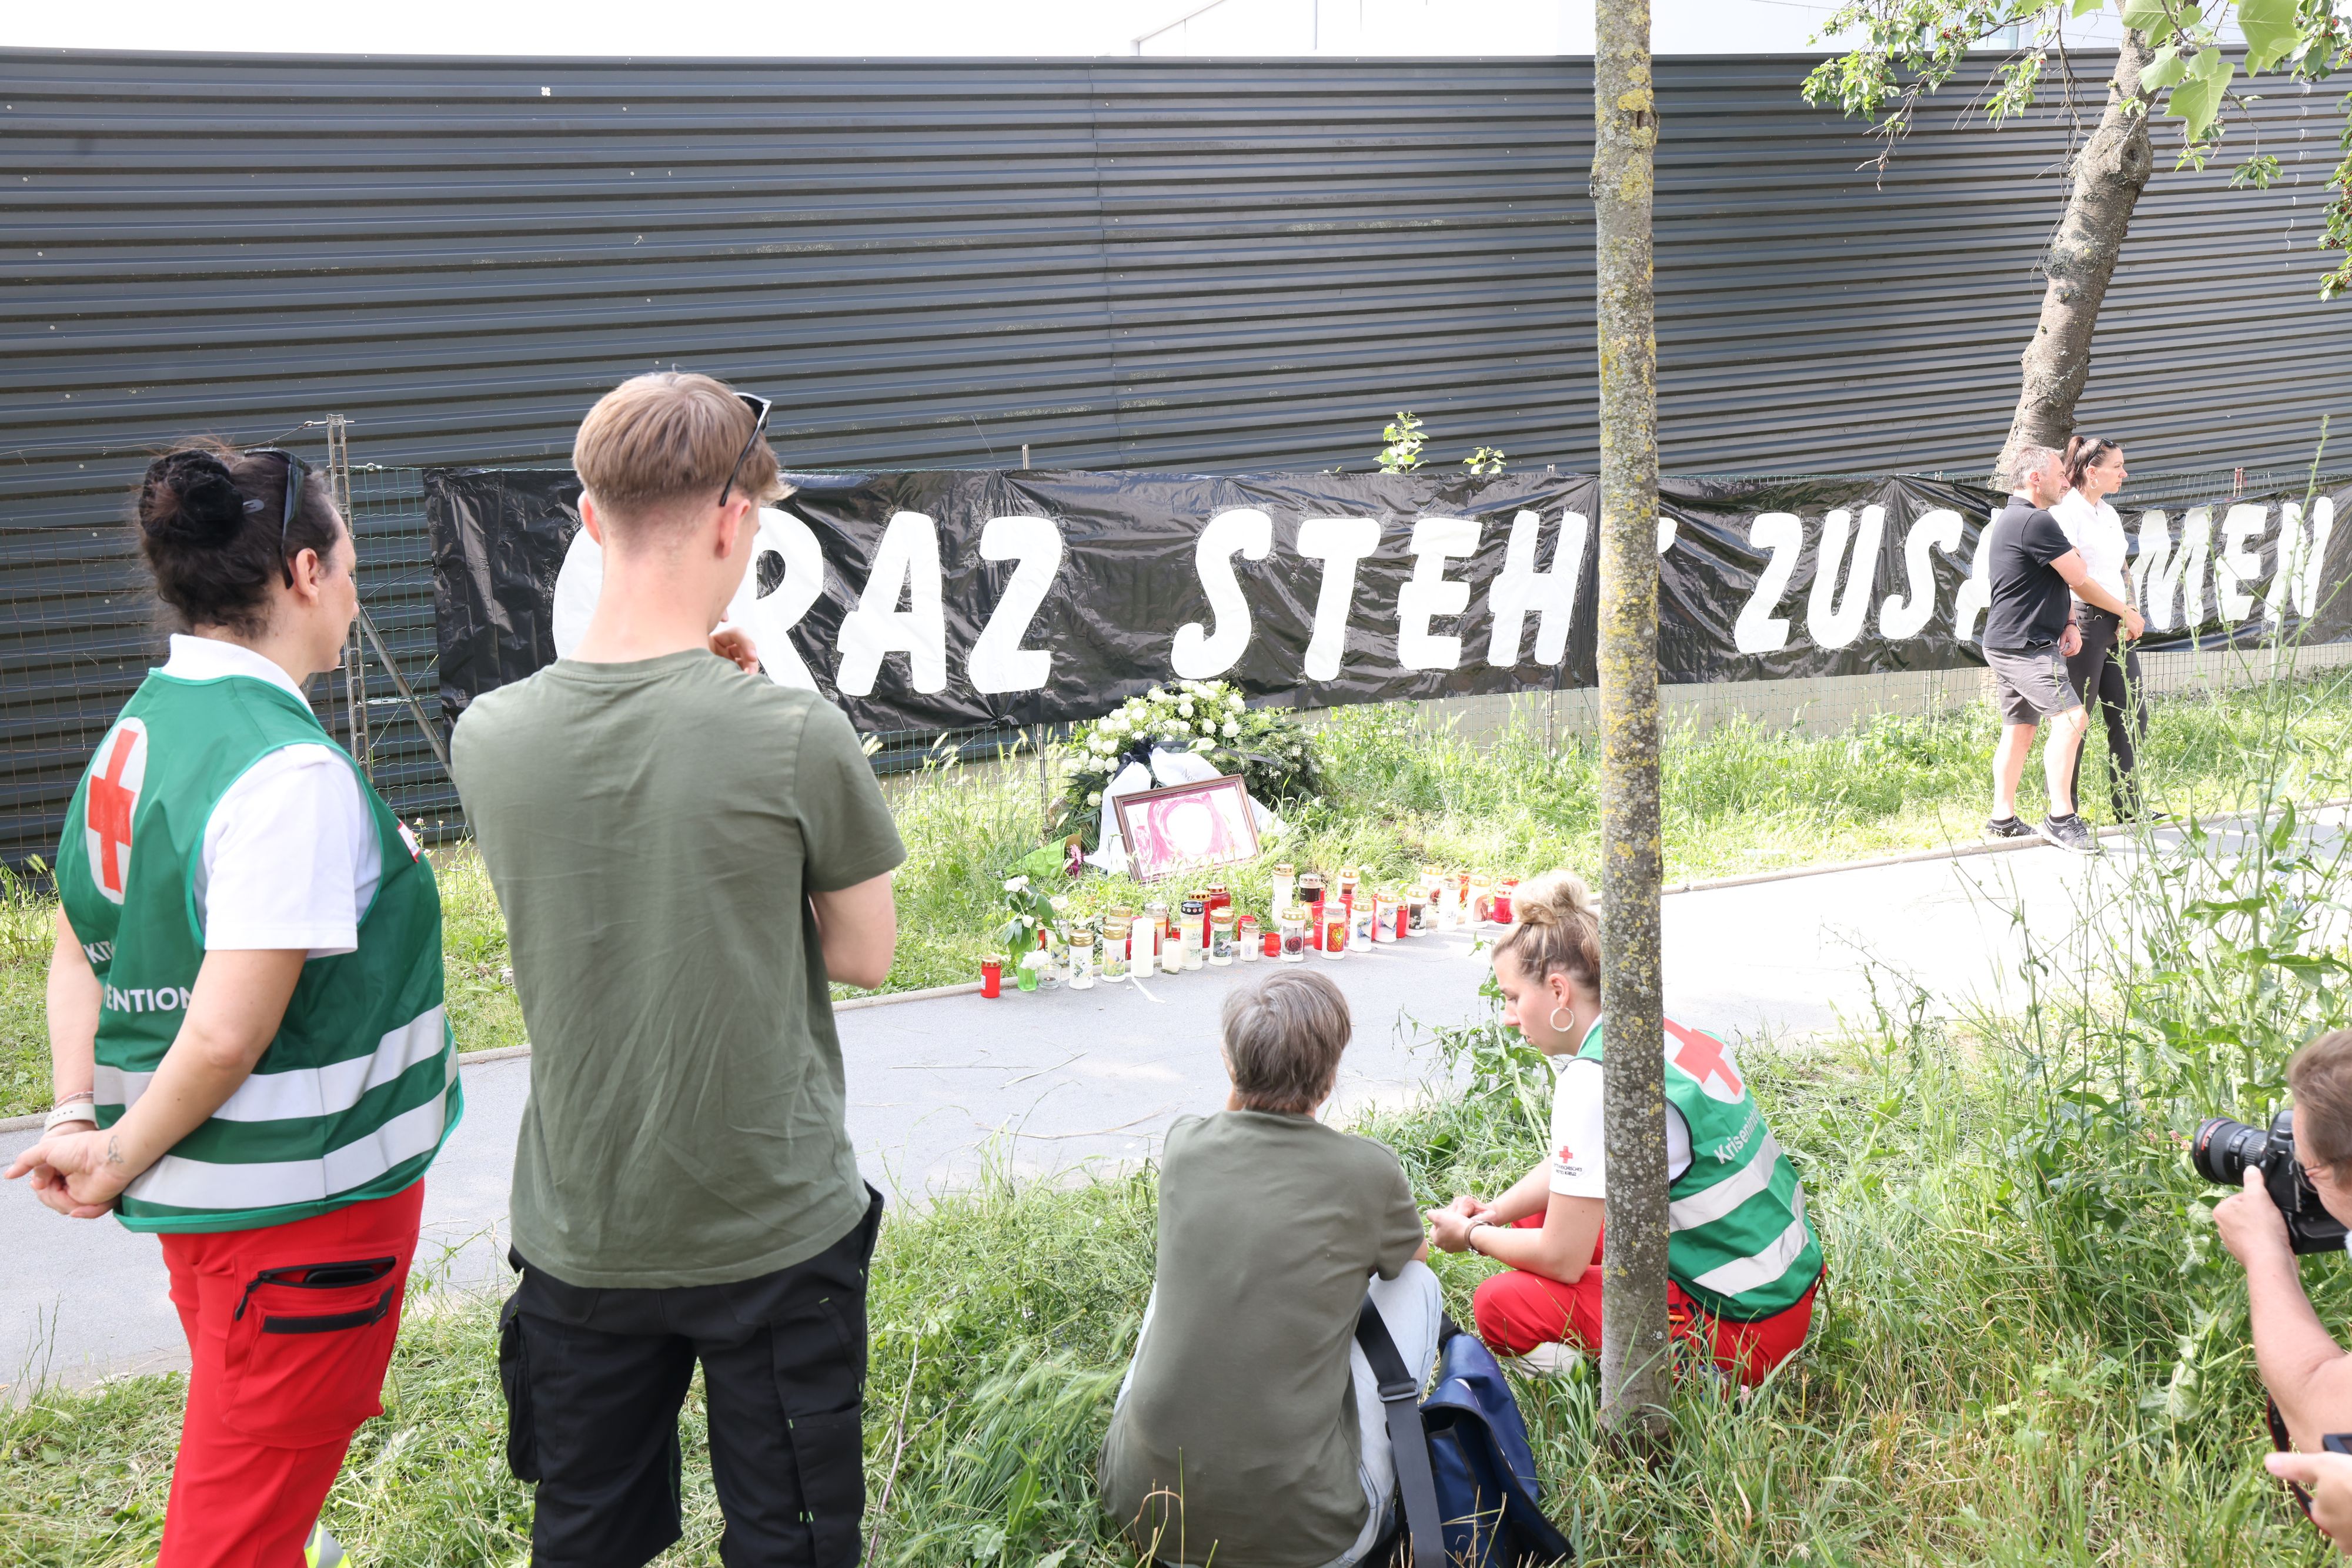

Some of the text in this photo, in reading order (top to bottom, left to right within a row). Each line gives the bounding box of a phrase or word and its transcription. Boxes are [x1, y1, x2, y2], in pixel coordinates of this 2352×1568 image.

[1171, 508, 1678, 681] STEH
[1181, 768, 1197, 782] Nor
[104, 982, 191, 1012] ENTION
